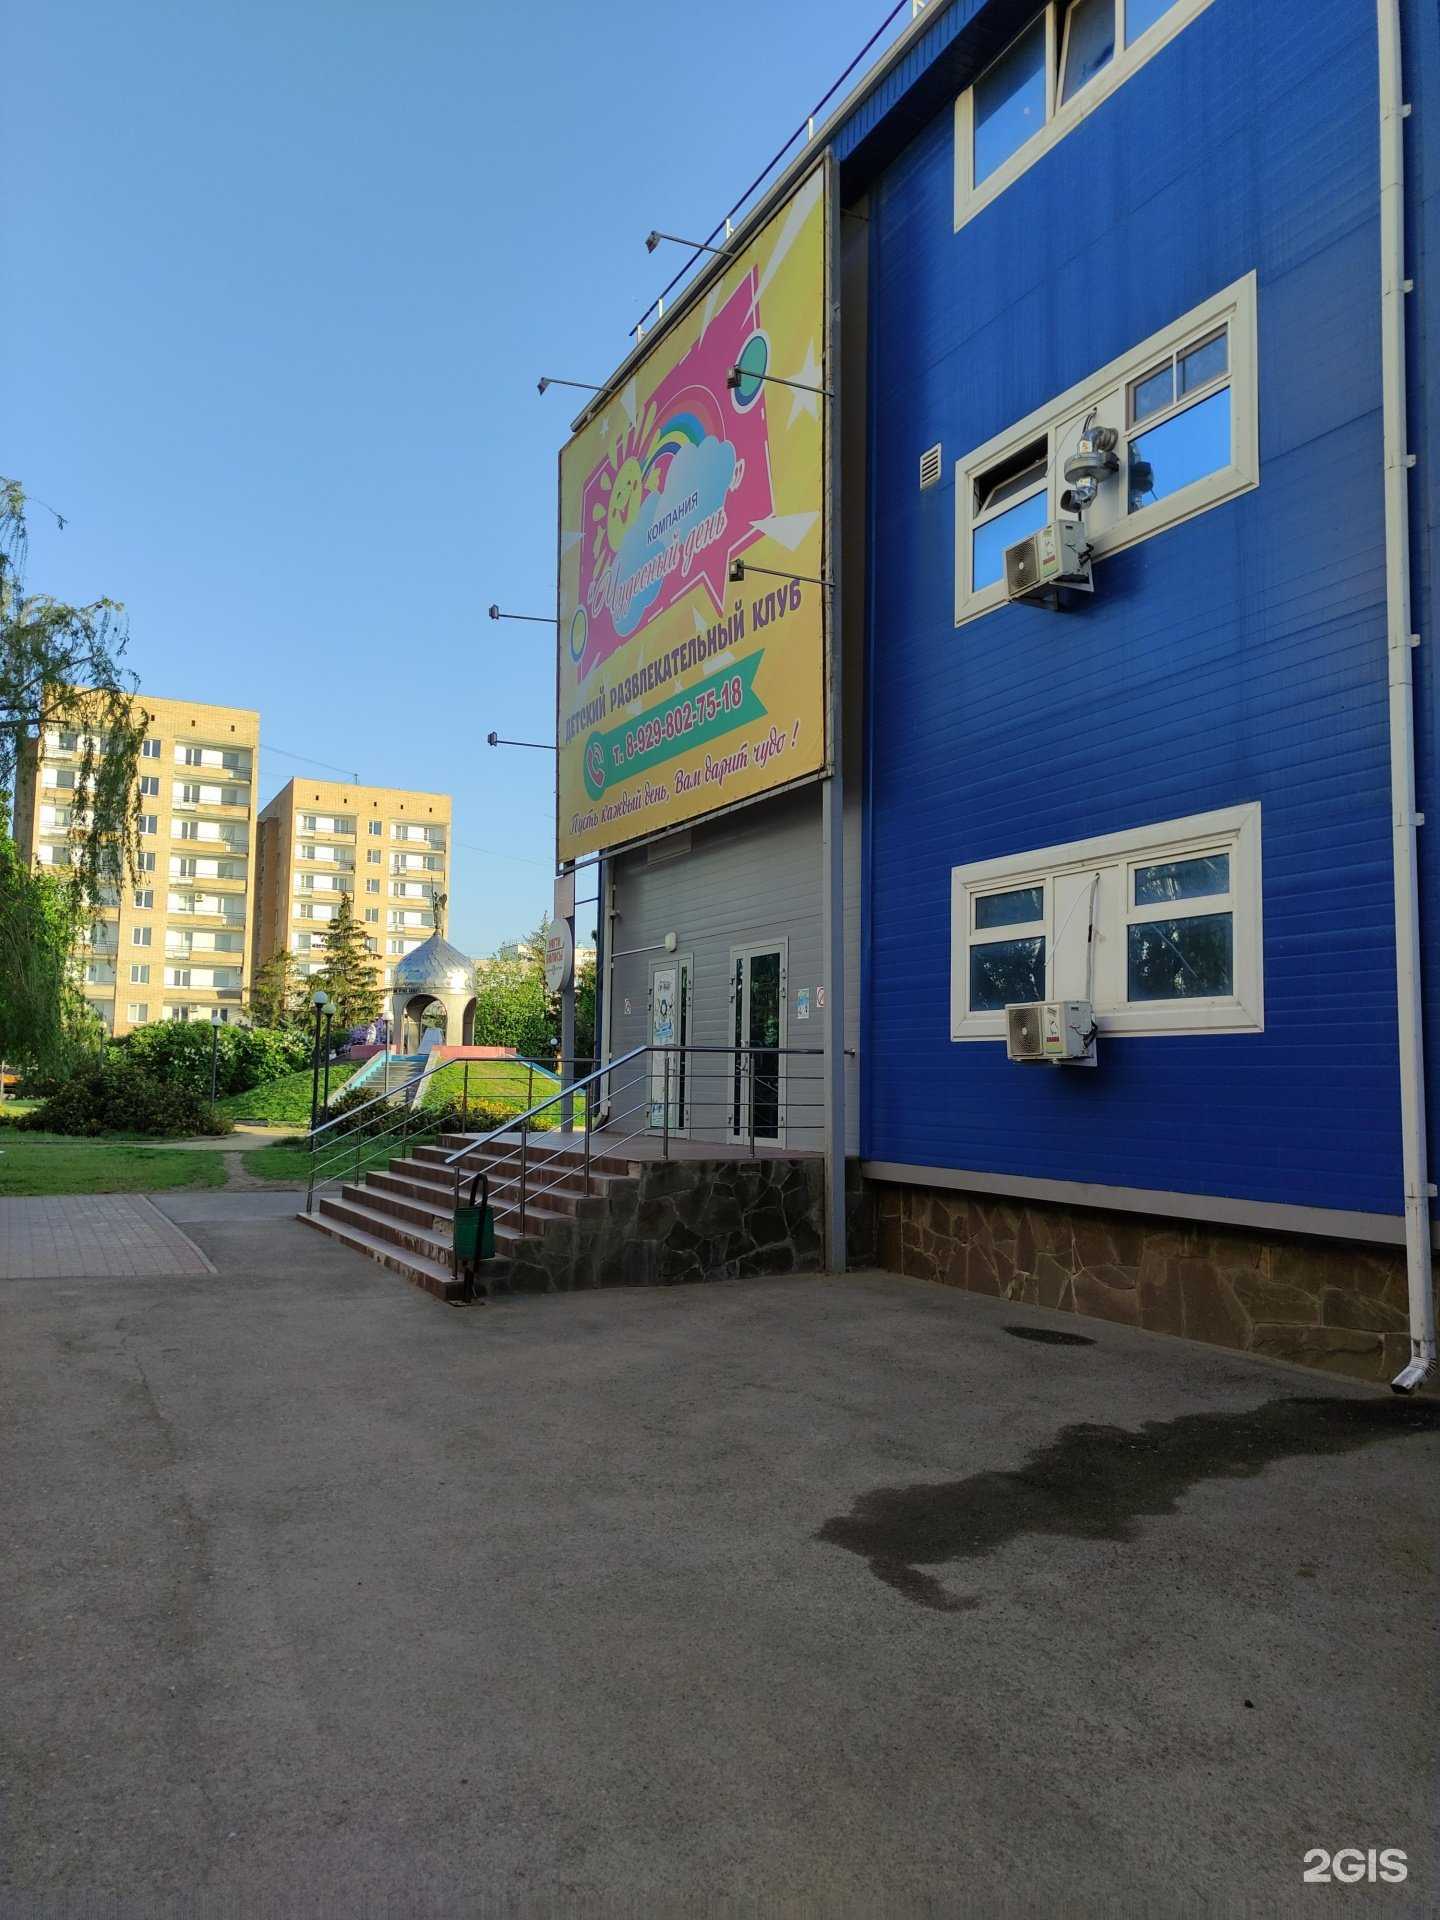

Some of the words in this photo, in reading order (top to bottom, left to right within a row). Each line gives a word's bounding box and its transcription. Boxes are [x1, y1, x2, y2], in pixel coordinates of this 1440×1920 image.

[646, 491, 699, 544] КОМПАНИЯ
[564, 684, 606, 745] ДЕТСКИЙ
[610, 599, 745, 712] РАЗВЛЕКАТЕЛЬНЫЙ
[752, 578, 802, 632] КЛУБ
[626, 675, 743, 760] 8-929-802-75-18
[570, 809, 599, 835] Пусть
[601, 789, 642, 824] каждый
[674, 768, 702, 795] Вам
[704, 742, 748, 786] дарит
